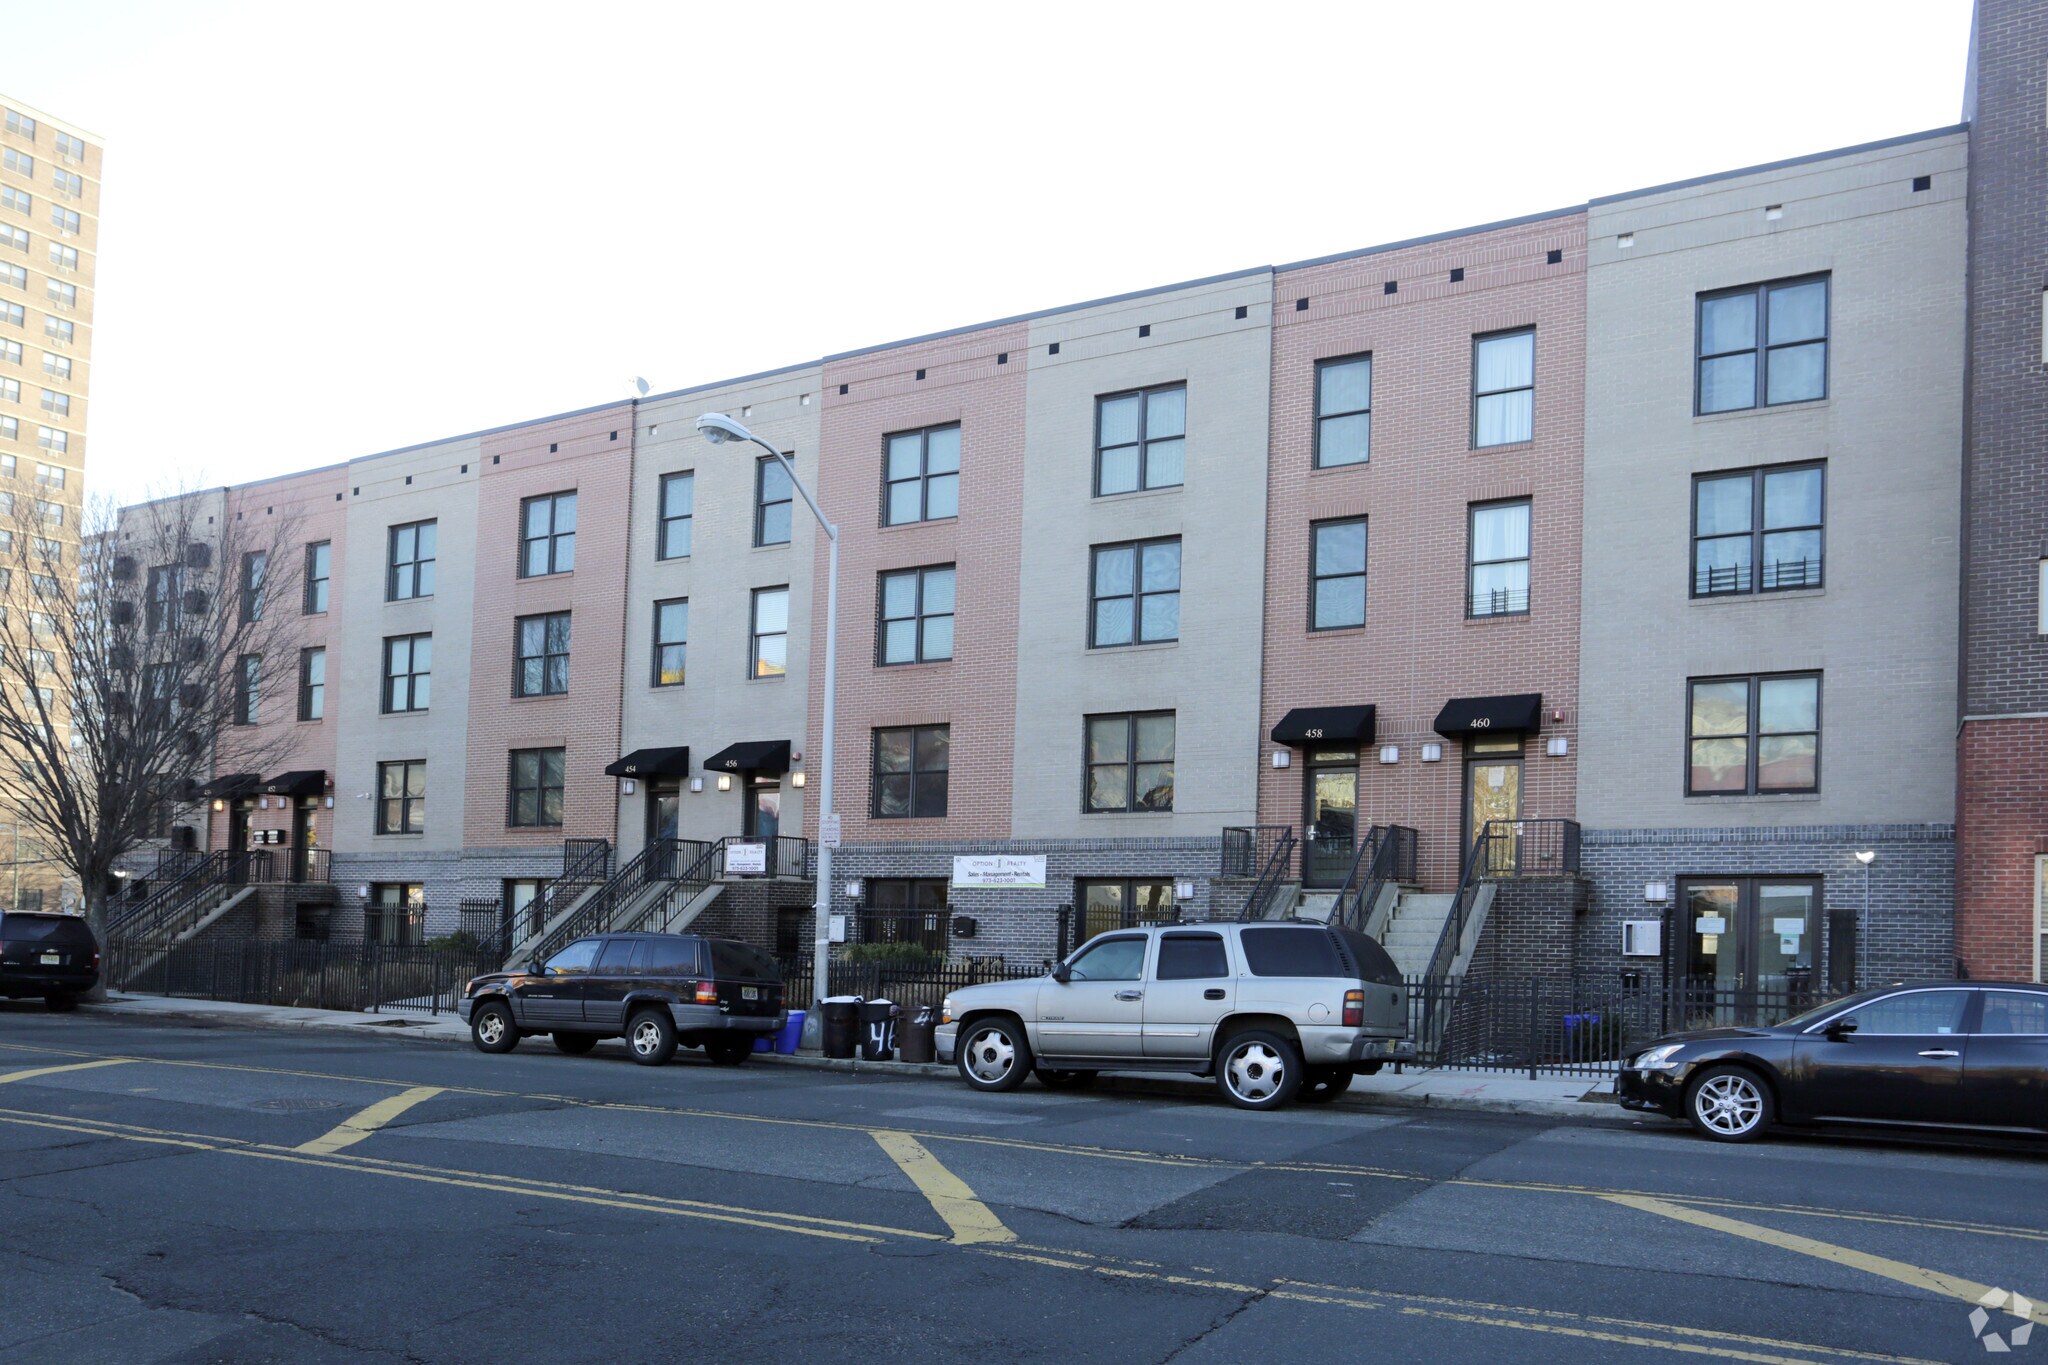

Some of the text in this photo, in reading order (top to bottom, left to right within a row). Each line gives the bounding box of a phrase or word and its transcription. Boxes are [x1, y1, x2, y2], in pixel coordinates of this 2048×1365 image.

[1470, 717, 1490, 729] 460
[1305, 728, 1323, 739] 458
[725, 760, 738, 768] 456
[624, 765, 636, 773] 454
